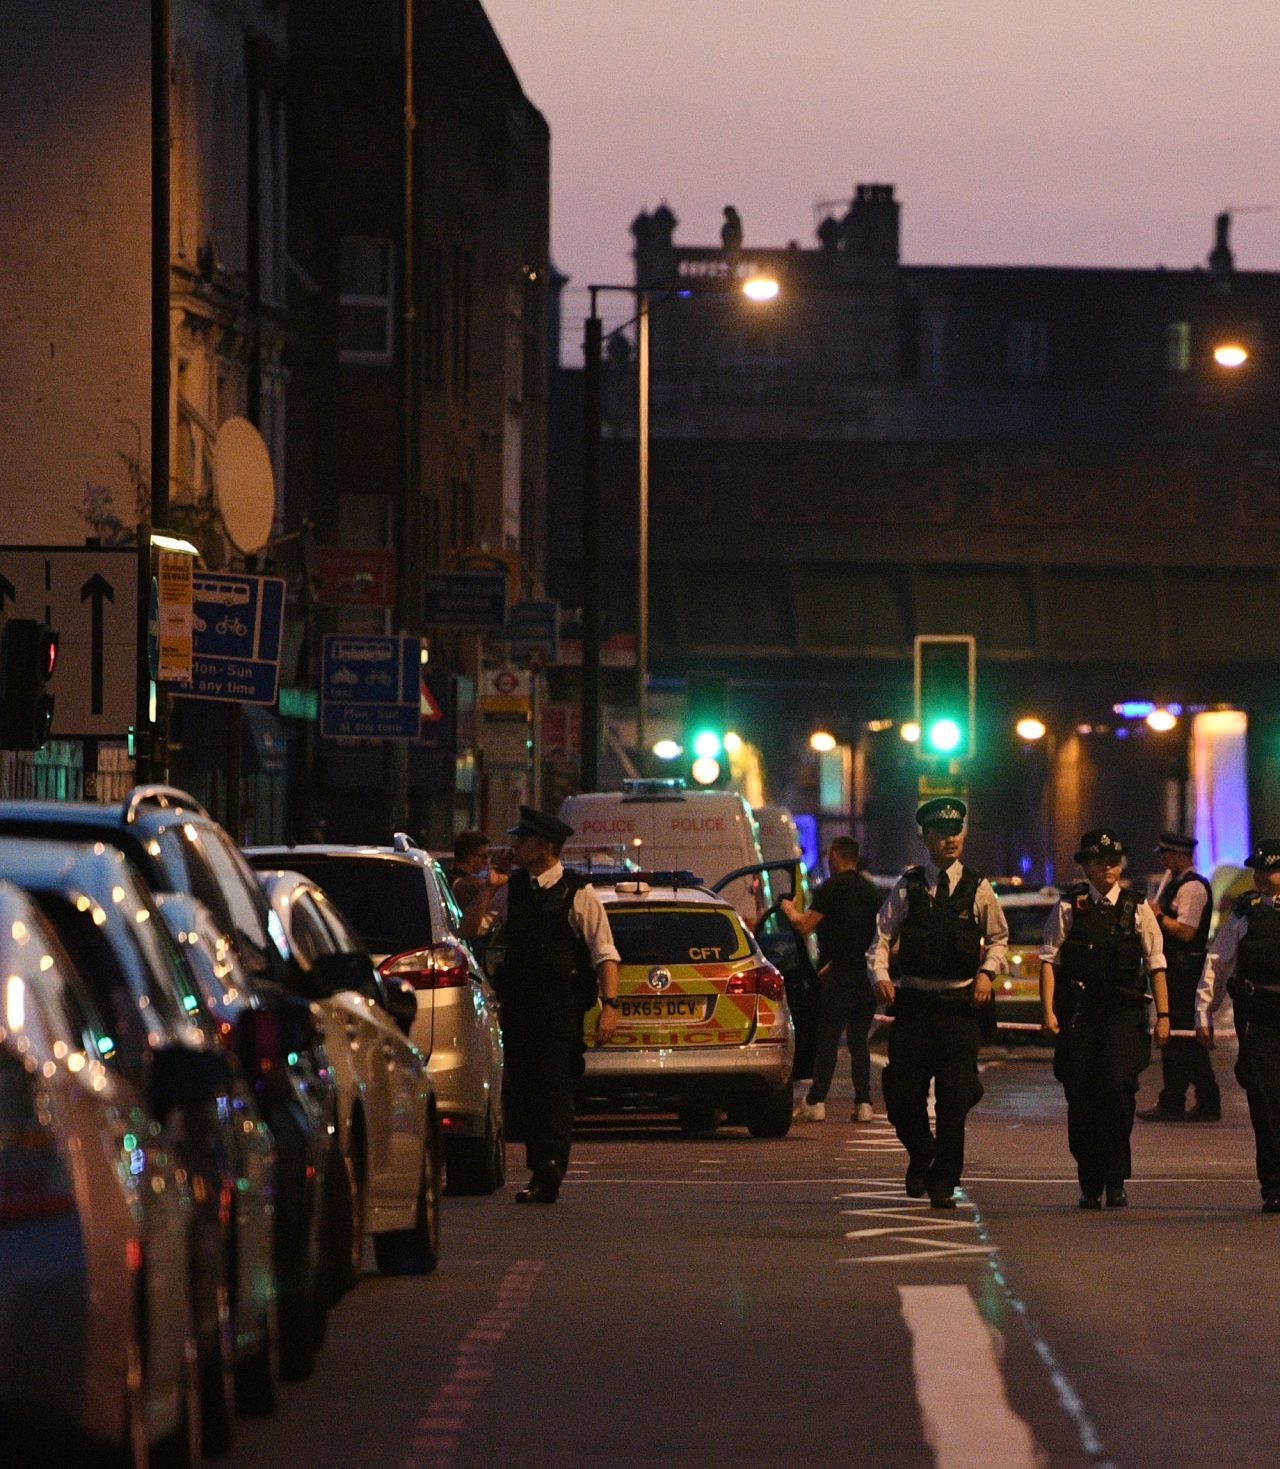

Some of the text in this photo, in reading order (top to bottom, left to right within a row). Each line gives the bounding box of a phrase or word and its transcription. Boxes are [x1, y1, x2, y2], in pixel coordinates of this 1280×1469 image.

[227, 664, 253, 678] Sun
[199, 683, 223, 694] any
[227, 680, 256, 695] time
[582, 820, 637, 833] POLICE
[671, 818, 725, 832] POLICE
[688, 947, 722, 960] CFT
[621, 1001, 697, 1017] BX65 DCV
